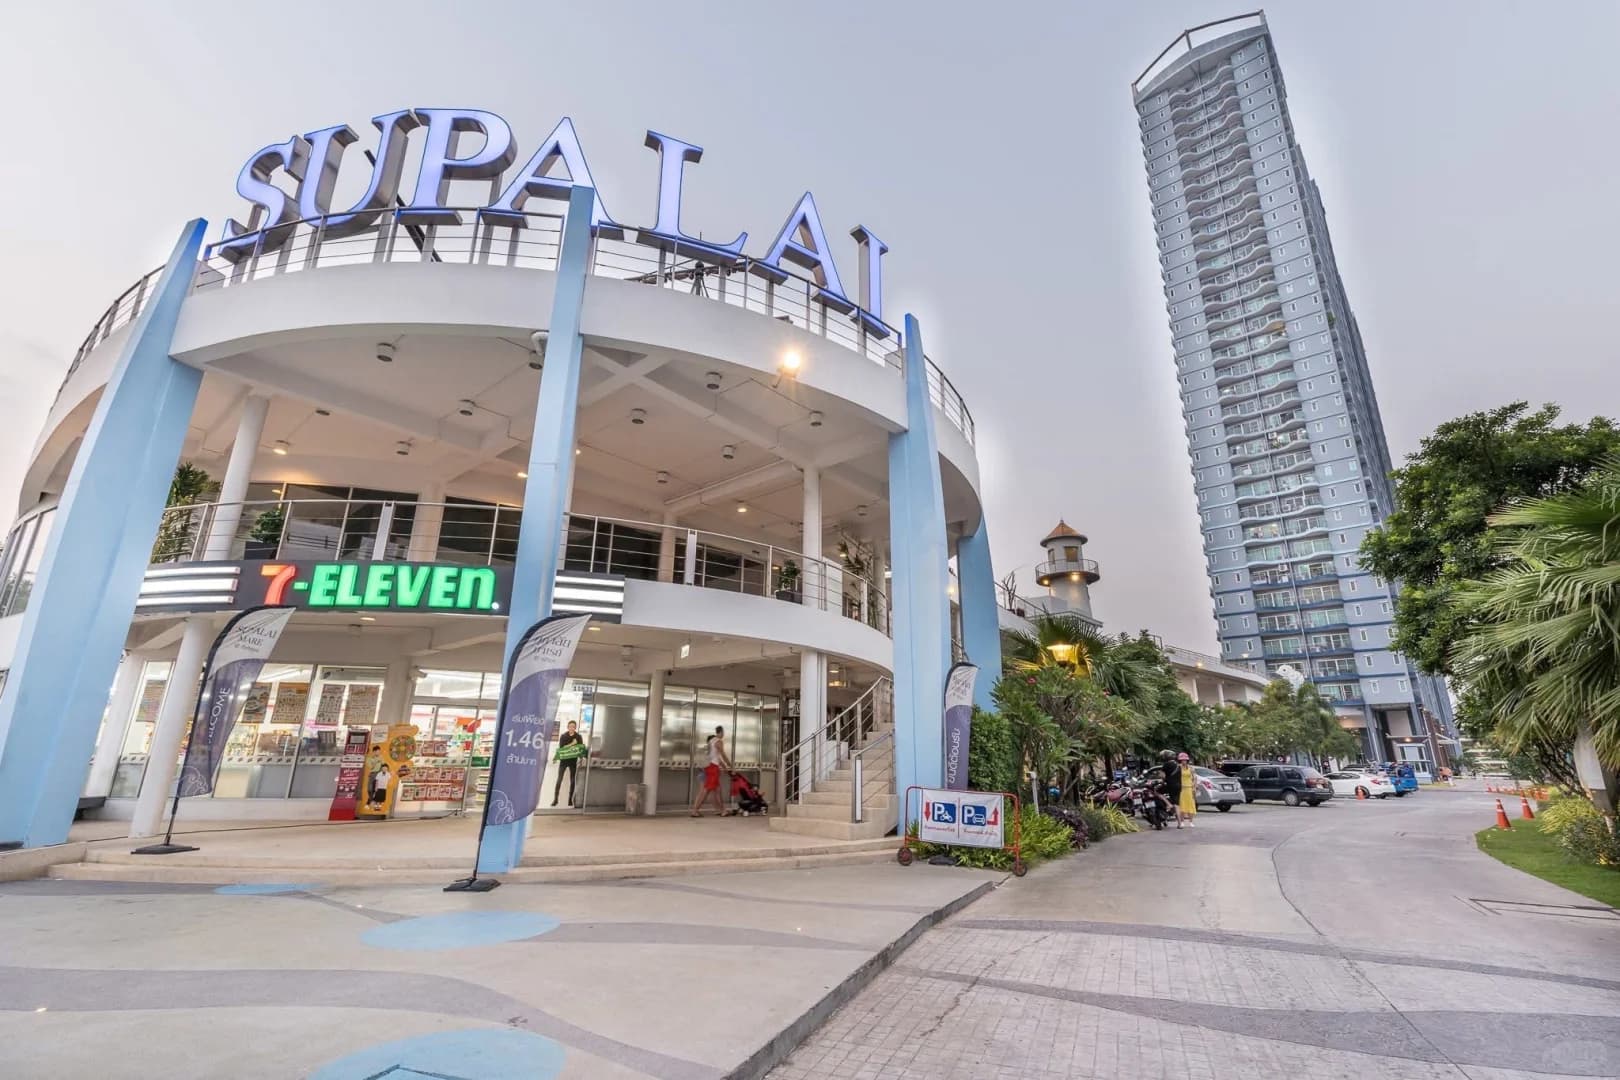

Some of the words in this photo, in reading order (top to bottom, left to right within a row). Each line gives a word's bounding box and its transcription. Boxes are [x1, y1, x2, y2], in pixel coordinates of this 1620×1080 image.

[218, 108, 891, 338] SUPALAI
[235, 626, 278, 640] SALAI
[208, 687, 231, 744] ELCOME
[505, 729, 545, 750] 1.46
[506, 753, 537, 766] ล้านบาท
[934, 803, 945, 821] P
[963, 806, 975, 824] P
